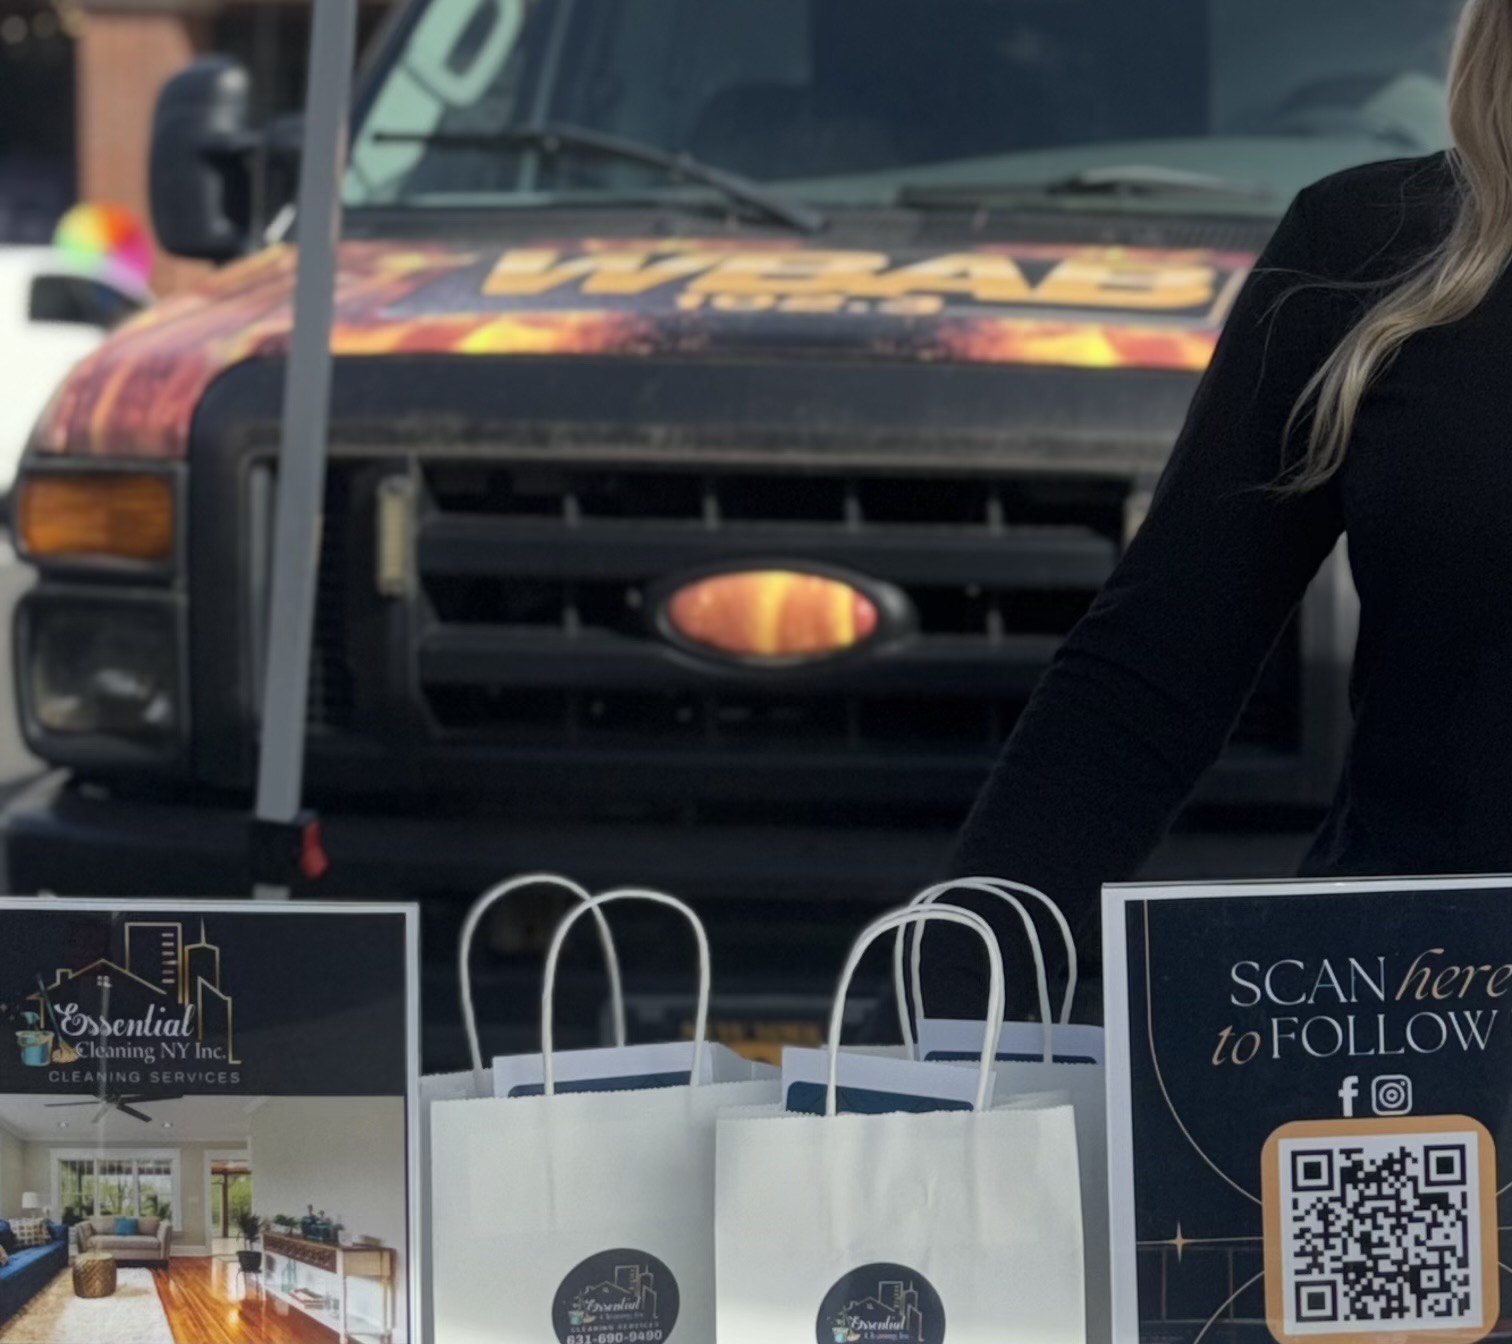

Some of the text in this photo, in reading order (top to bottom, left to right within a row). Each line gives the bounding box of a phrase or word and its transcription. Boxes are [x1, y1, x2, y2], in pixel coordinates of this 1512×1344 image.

[483, 253, 1214, 309] WBAB
[1230, 957, 1386, 1007] SCAN
[54, 1003, 195, 1036] Essential
[1212, 1025, 1261, 1065] to
[1271, 1010, 1498, 1059] FOLLOW
[75, 1041, 226, 1064] Cleaning NY Inc.
[49, 1071, 240, 1083] CLEANING SERVICES
